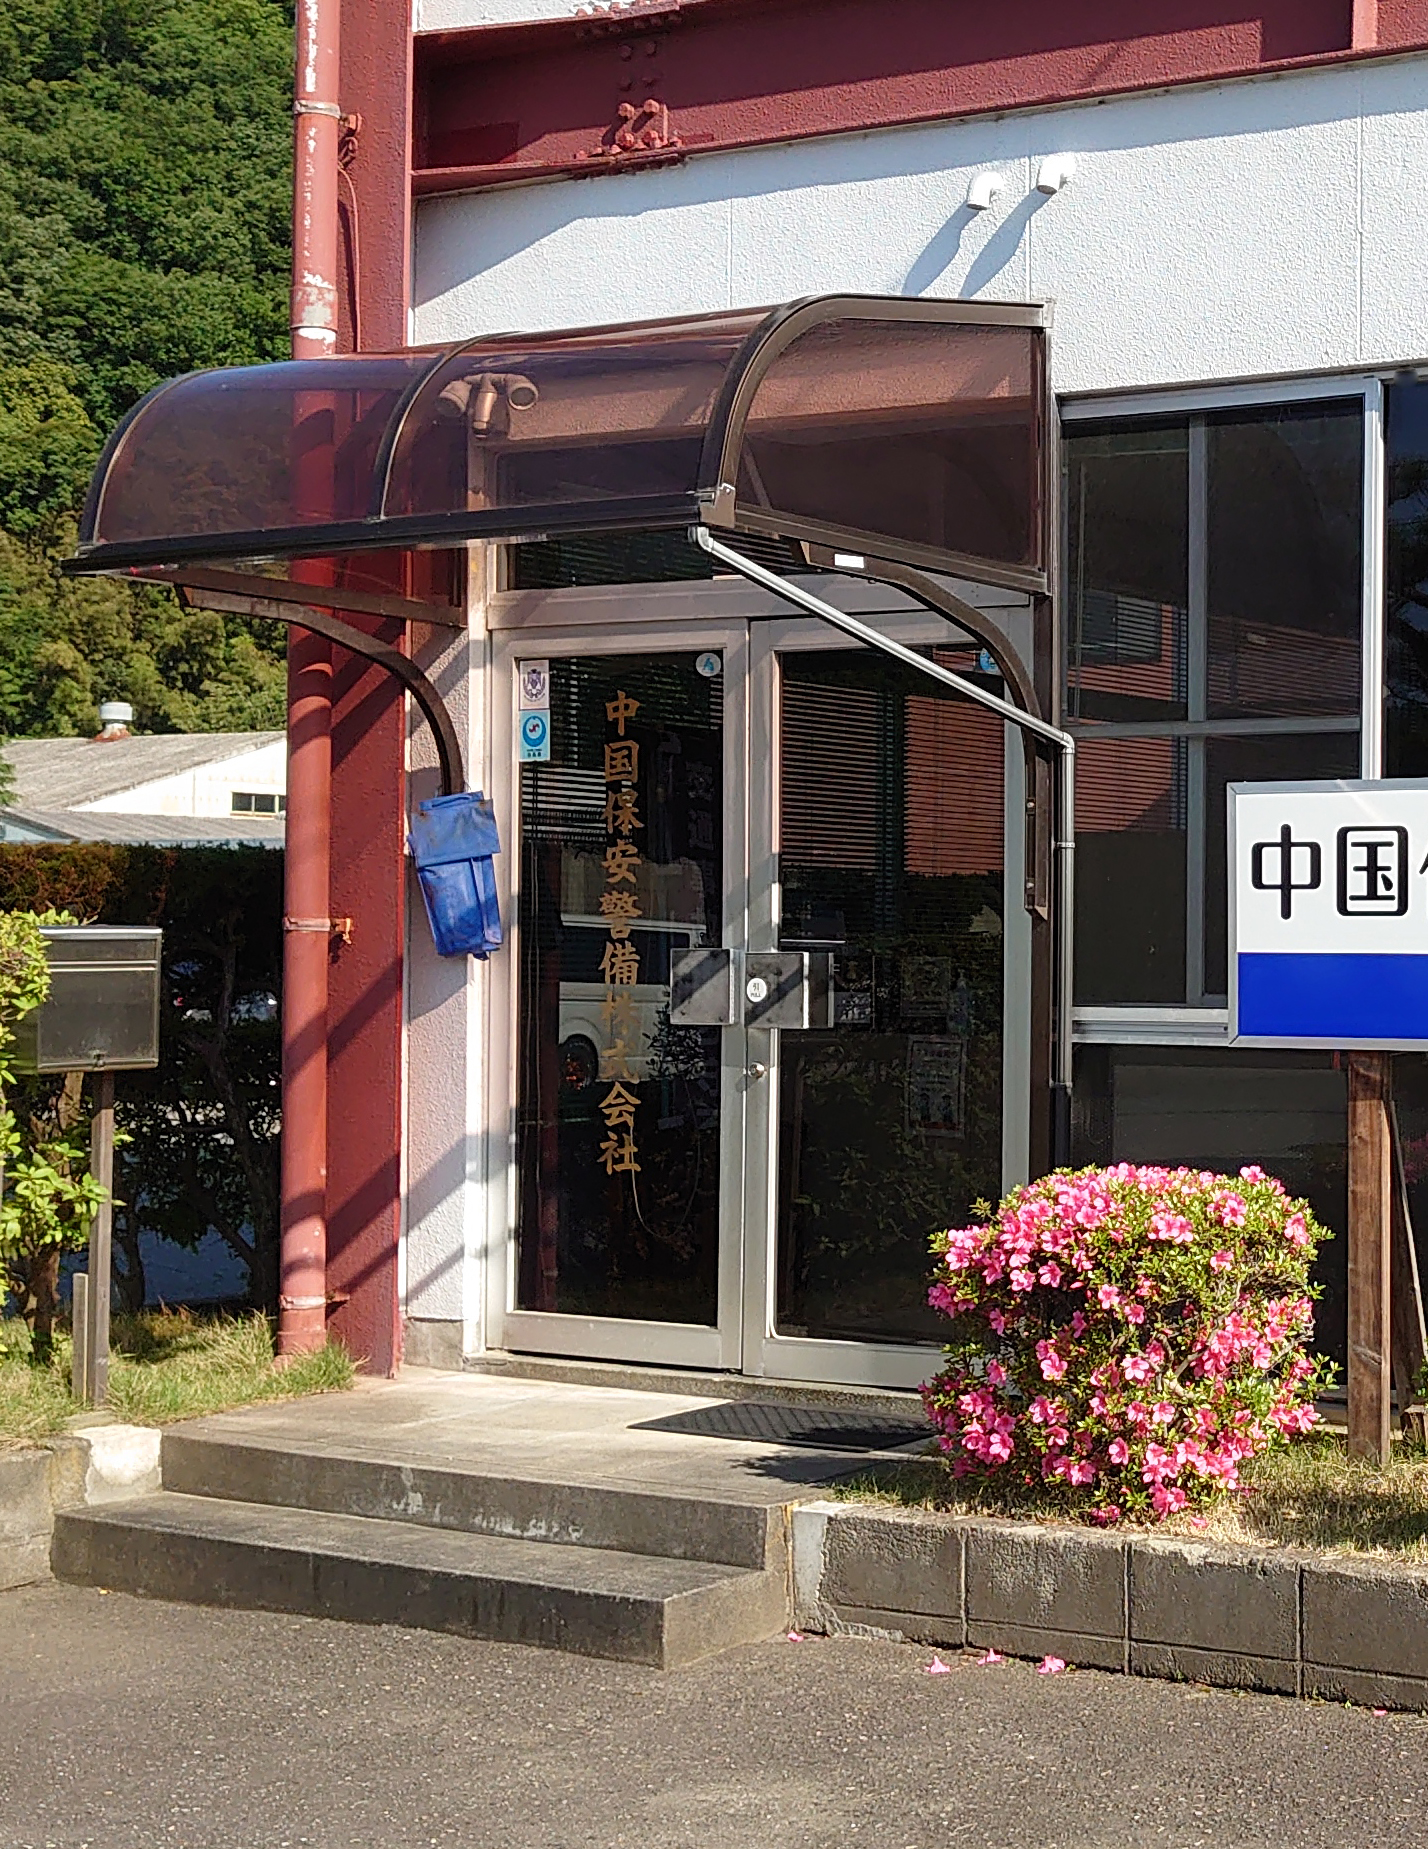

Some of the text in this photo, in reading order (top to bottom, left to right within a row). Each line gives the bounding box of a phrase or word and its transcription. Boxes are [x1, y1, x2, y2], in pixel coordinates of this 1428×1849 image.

[598, 689, 642, 1176] 中国保安警備株式会社
